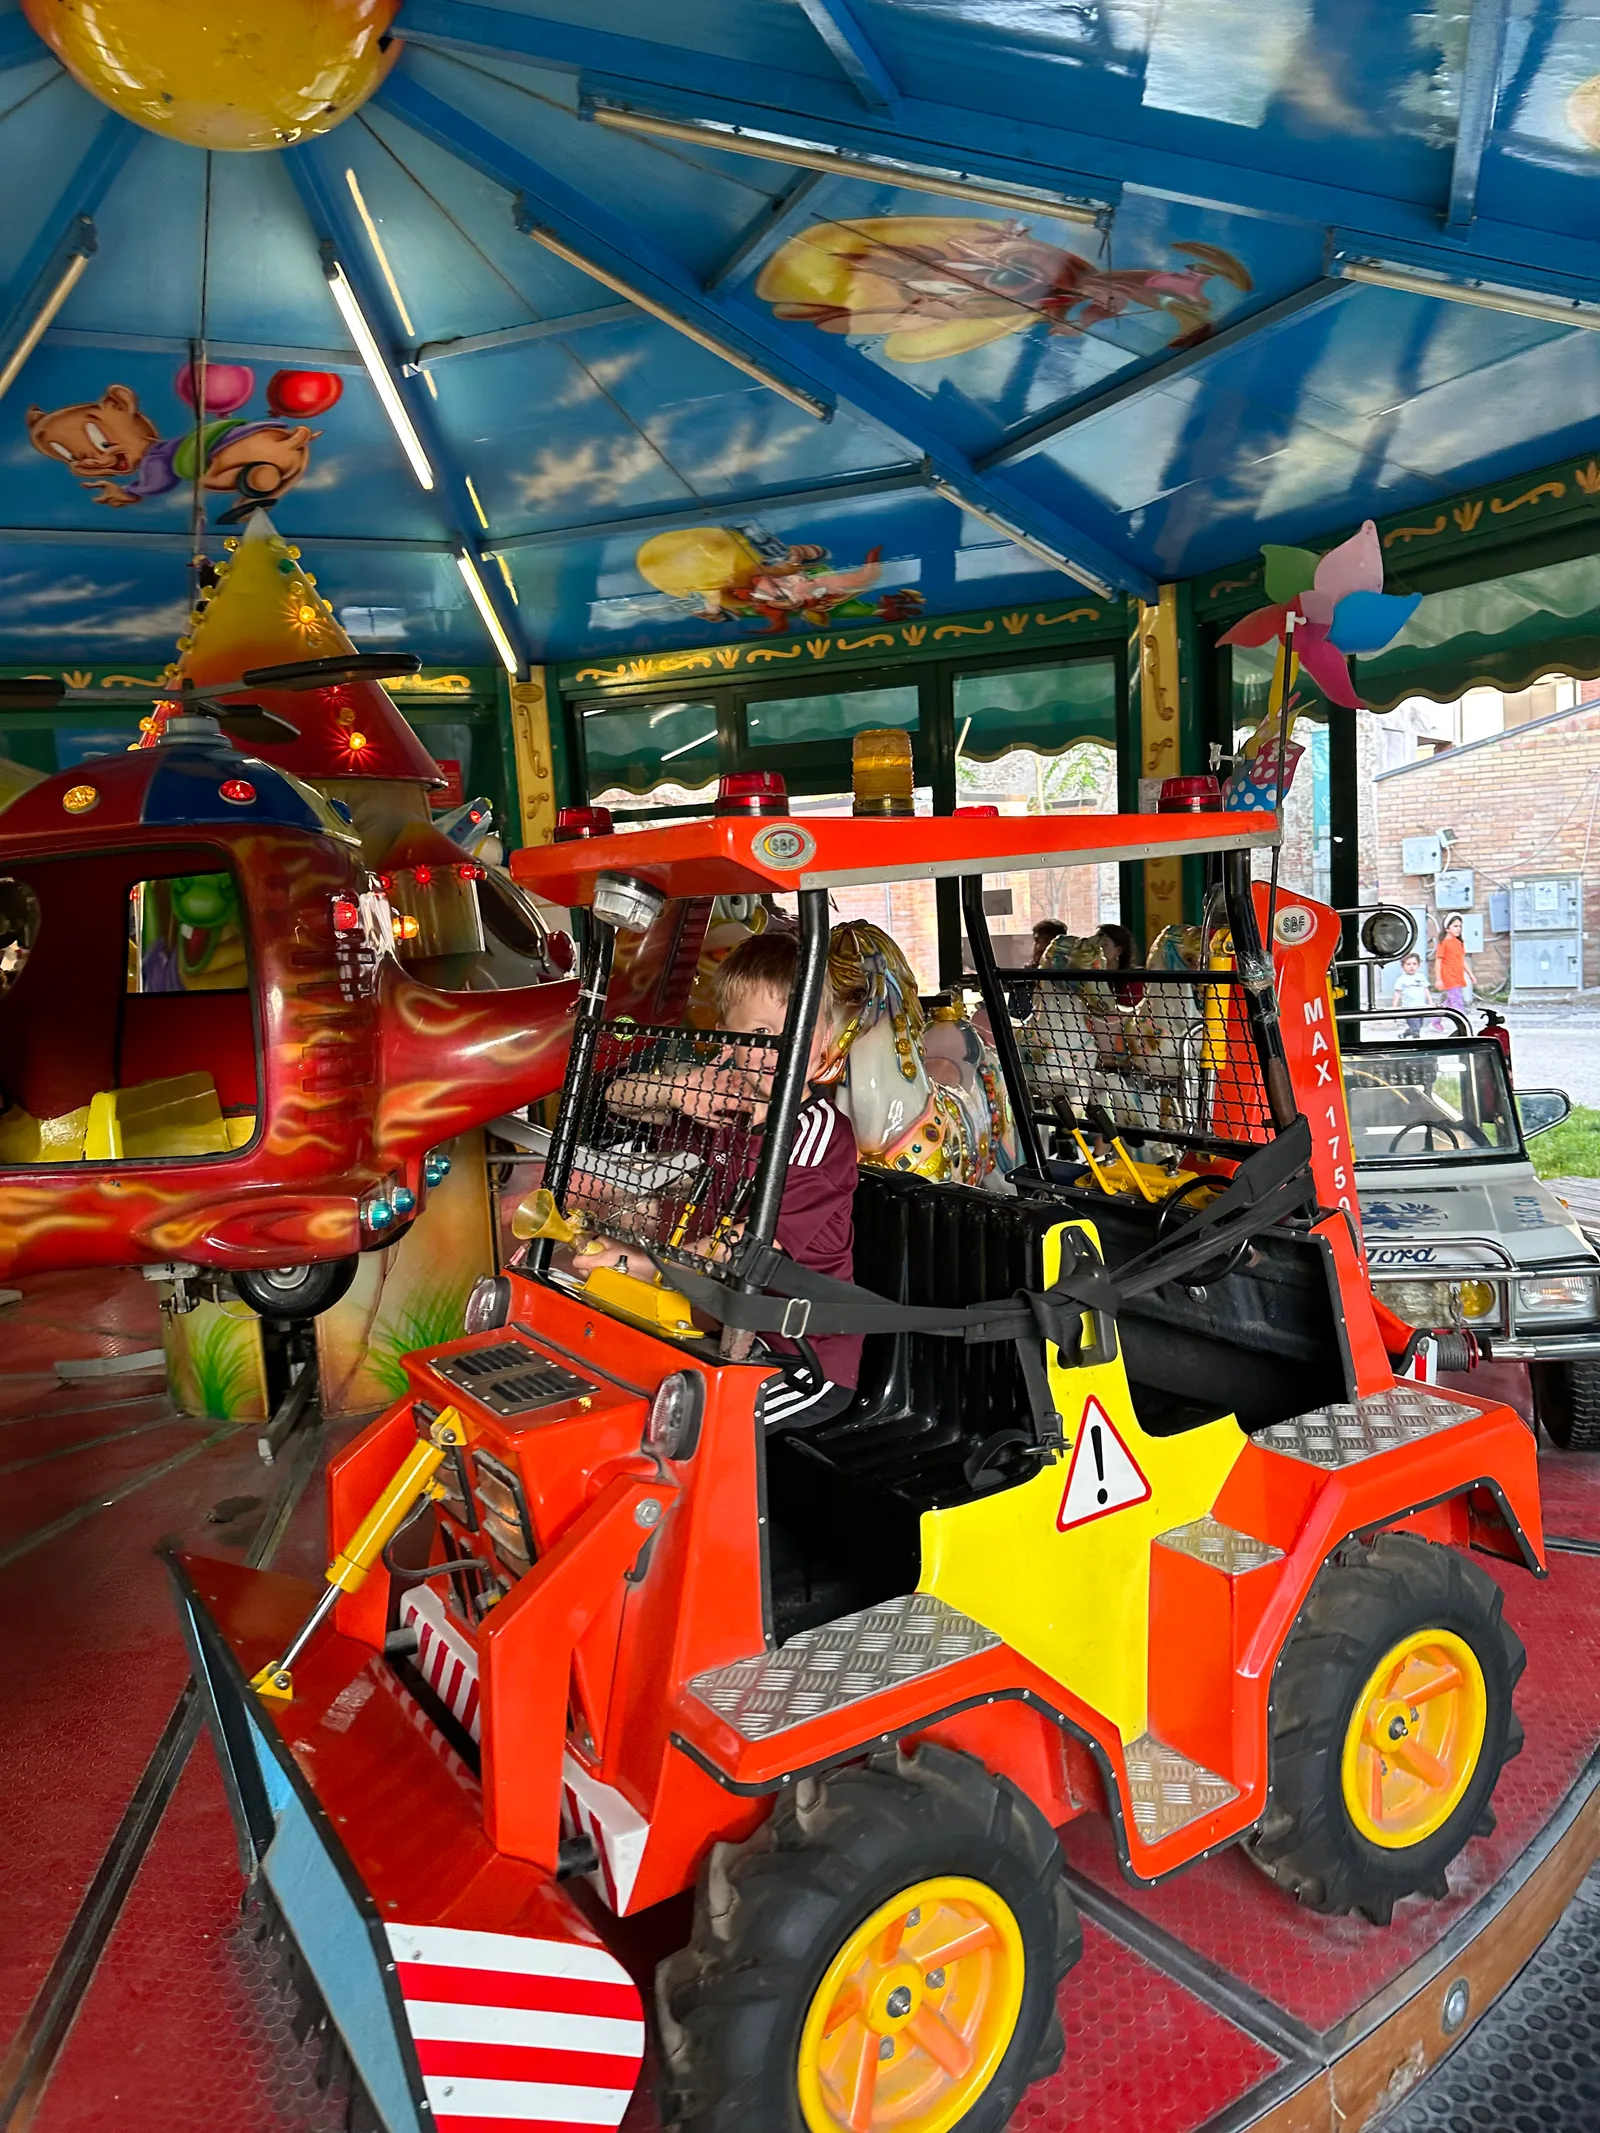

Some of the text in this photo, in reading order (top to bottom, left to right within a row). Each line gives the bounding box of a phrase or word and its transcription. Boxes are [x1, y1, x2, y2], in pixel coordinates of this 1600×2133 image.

[771, 838, 796, 852] SBF
[1282, 915, 1306, 933] SBF
[1303, 997, 1333, 1087] MAX
